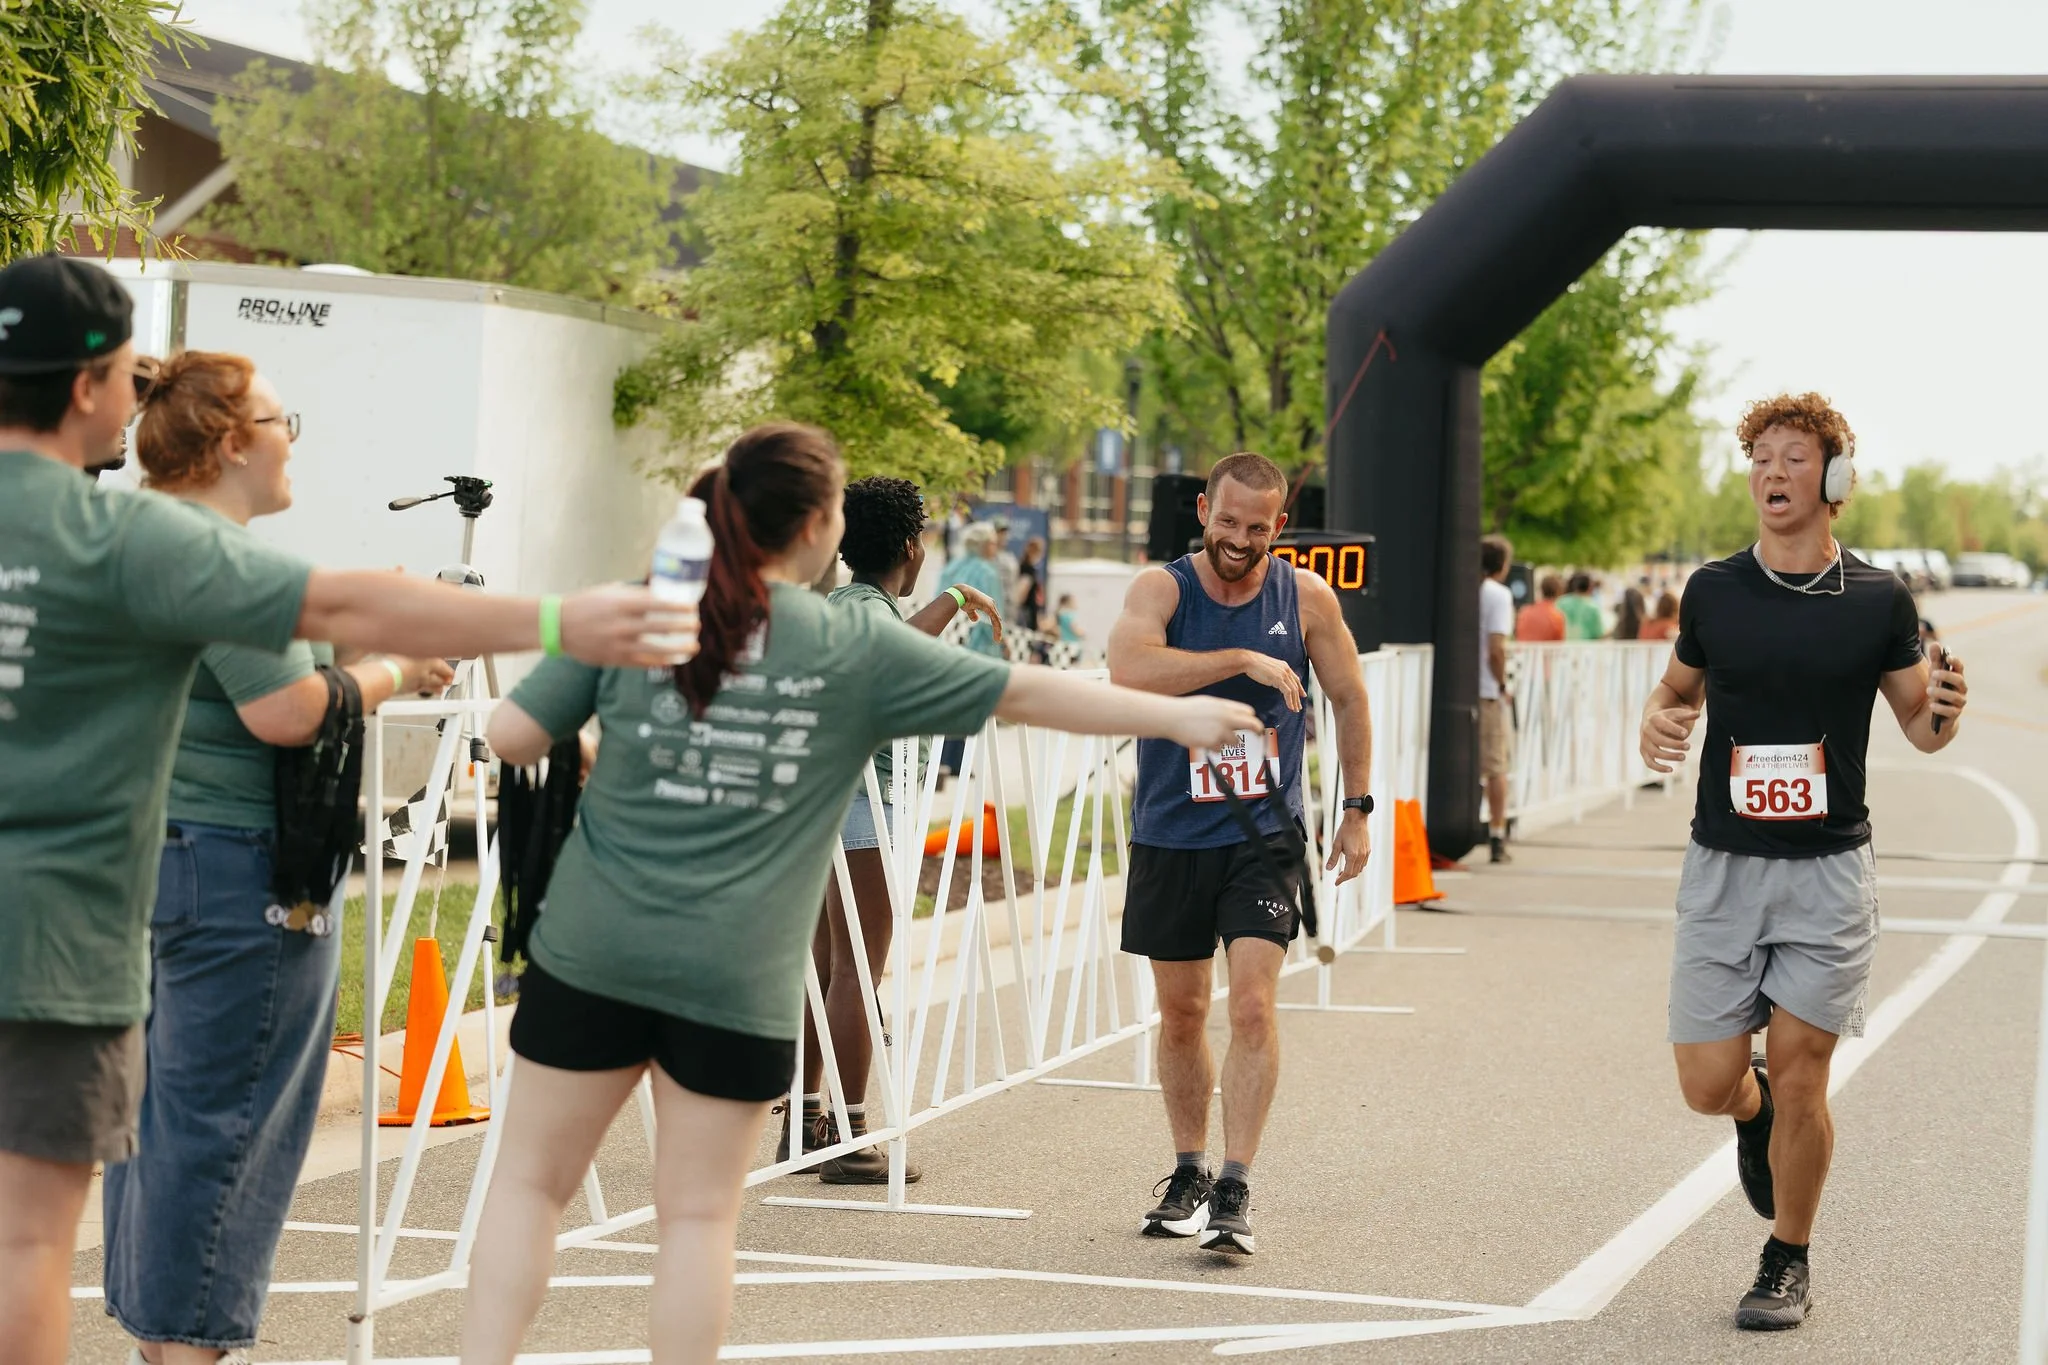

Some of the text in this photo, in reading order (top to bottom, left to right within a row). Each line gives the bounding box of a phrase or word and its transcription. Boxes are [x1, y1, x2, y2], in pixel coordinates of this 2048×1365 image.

[1220, 748, 1246, 757] LIVES
[1753, 754, 1808, 763] freedom424
[1196, 761, 1272, 794] 1814
[1746, 778, 1812, 813] 563
[1257, 899, 1290, 912] HYROX
